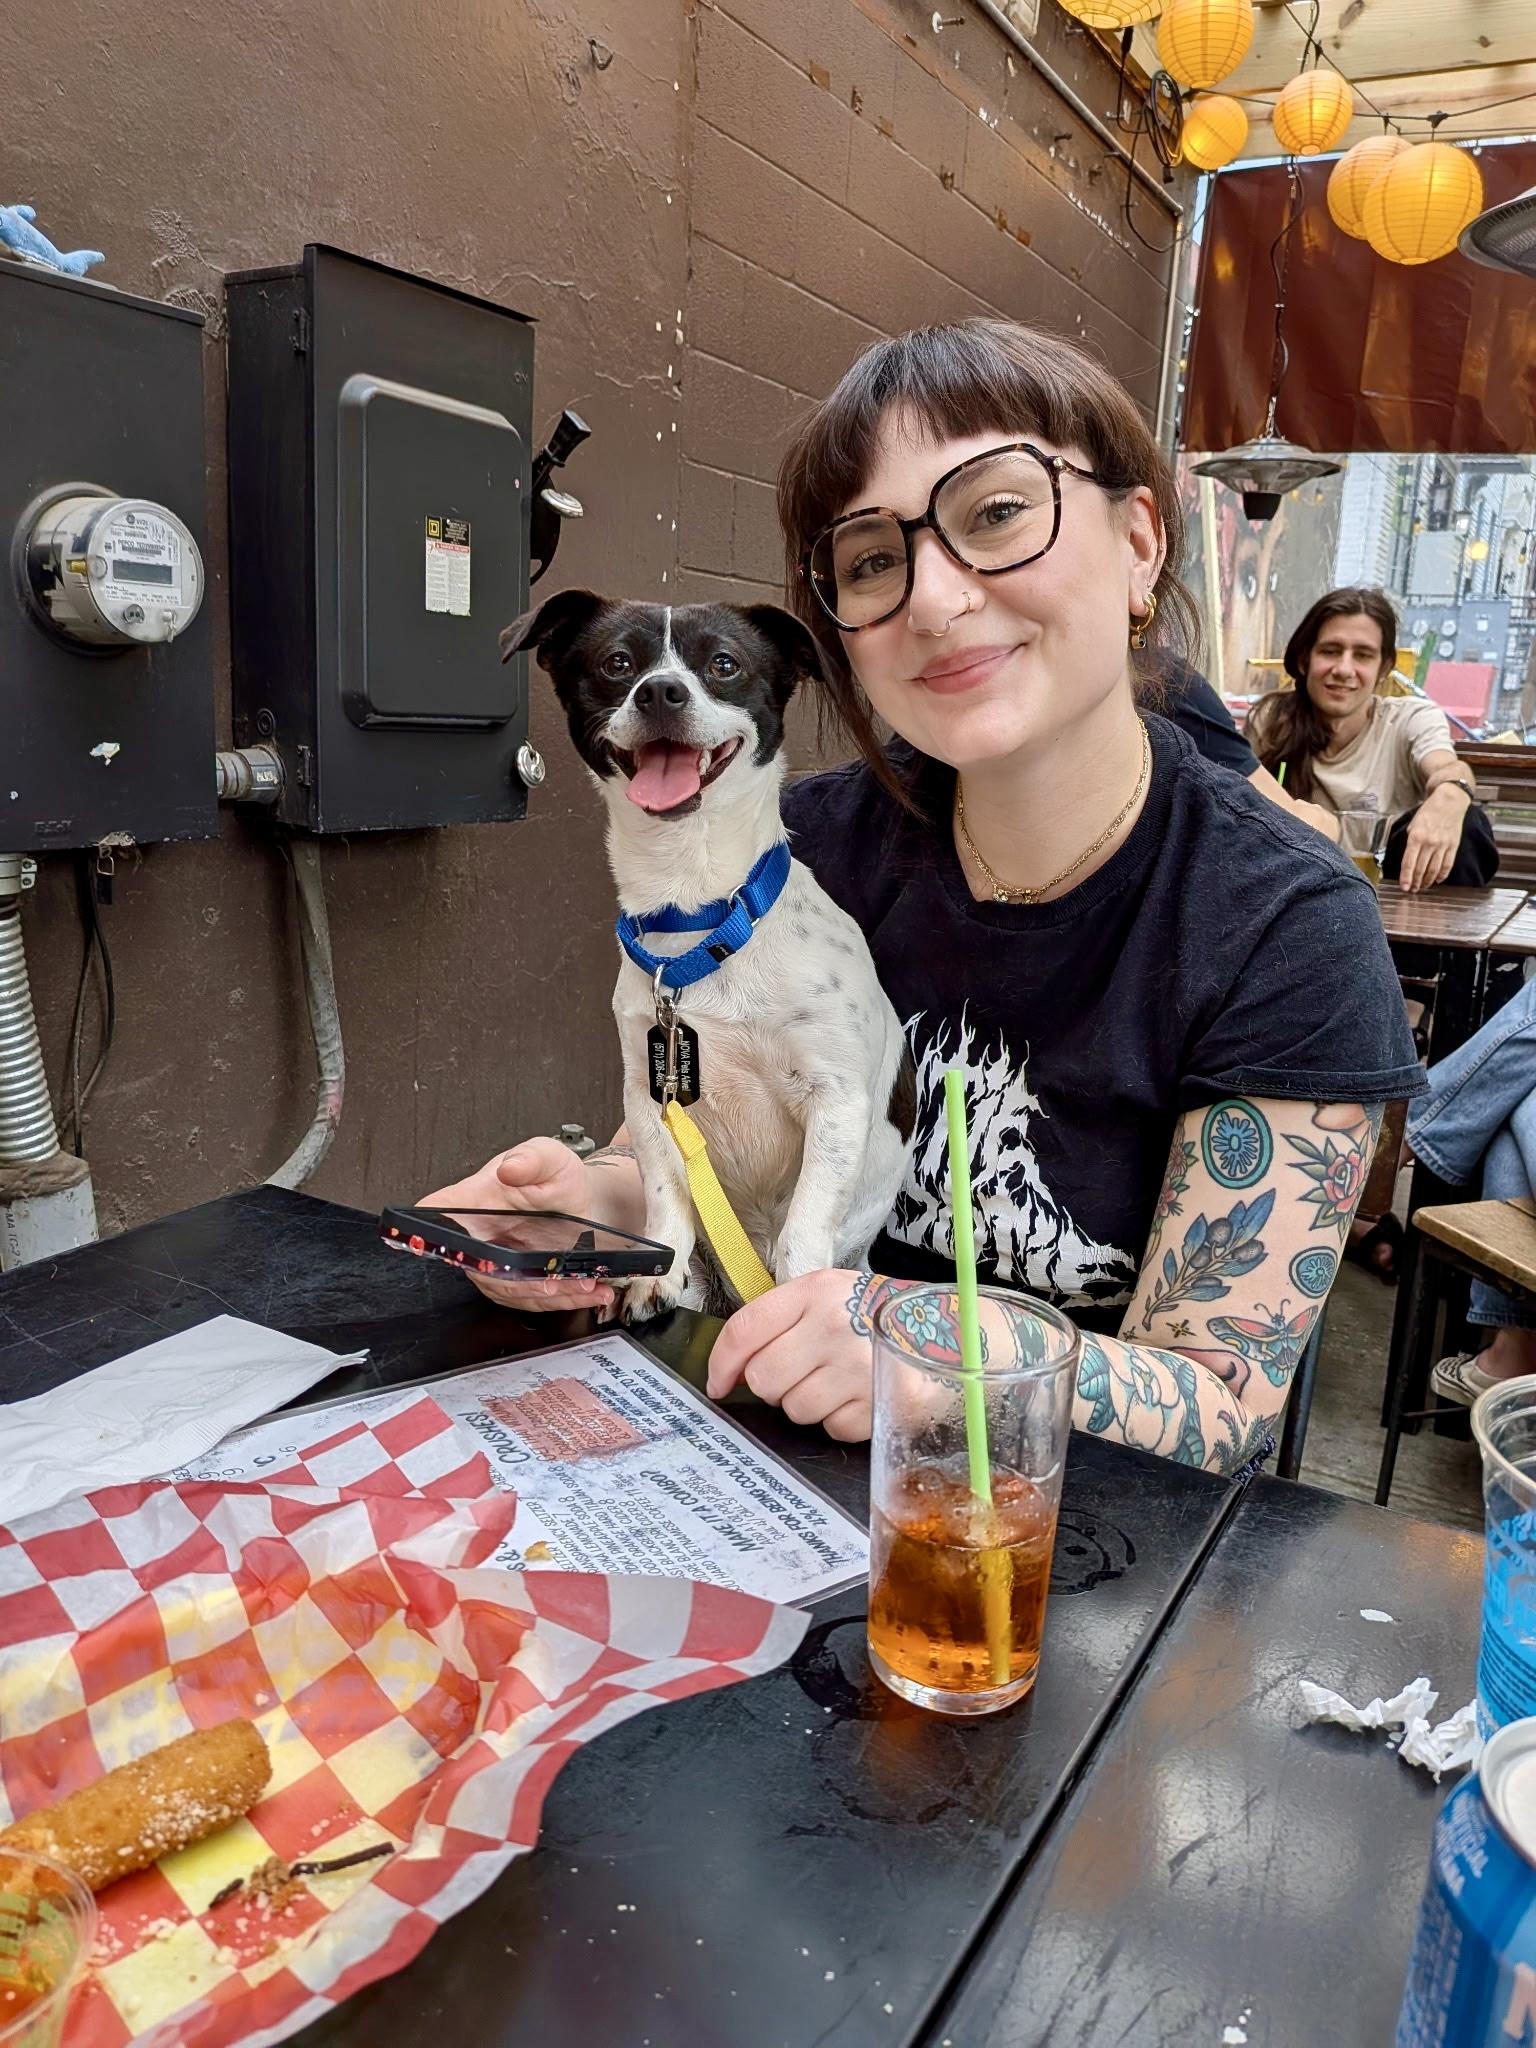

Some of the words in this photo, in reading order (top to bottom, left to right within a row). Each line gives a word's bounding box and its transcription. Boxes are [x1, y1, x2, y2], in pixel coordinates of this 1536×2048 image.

[652, 1042, 665, 1059] (571)
[681, 1040, 691, 1059] NOVA
[604, 1366, 628, 1379] THE
[620, 1378, 638, 1388] TO
[633, 1369, 674, 1396] PAYMENTS
[630, 1387, 670, 1414] EMPTIES
[665, 1396, 692, 1411] CASH
[598, 1417, 622, 1434] SODA
[684, 1412, 708, 1425] NON
[458, 1411, 530, 1463] CRUSHES!
[512, 1429, 540, 1445] THAT
[662, 1414, 714, 1452] RETURNING
[700, 1425, 719, 1435] TO
[529, 1446, 557, 1462] GET
[712, 1434, 745, 1457] ADDED
[706, 1452, 734, 1466] AND
[735, 1453, 759, 1466] FEE
[555, 1472, 579, 1488] SODA
[725, 1466, 757, 1488] COOL
[624, 1488, 643, 1497] 11
[640, 1470, 698, 1505] COMBO?
[752, 1467, 811, 1509] PROCESSING
[572, 1489, 603, 1511] ITALIAN
[702, 1492, 721, 1503] OF
[749, 1489, 787, 1513] BEING
[526, 1502, 557, 1527] SELTZER
[566, 1503, 591, 1520] SODA
[607, 1505, 632, 1524] CIDER
[627, 1507, 654, 1526] CIDER
[634, 1497, 665, 1519] COFFEE
[713, 1502, 734, 1515] POP
[733, 1504, 755, 1518] CALL
[800, 1507, 828, 1526] 4%
[594, 1511, 619, 1529] HARD
[698, 1515, 724, 1523] IT
[778, 1513, 808, 1531] FOR
[561, 1518, 602, 1552] LEMONADE
[582, 1521, 623, 1554] PINEAPPLE
[658, 1520, 708, 1560] VIETNAMESE
[712, 1519, 764, 1552] MAKE
[751, 1532, 776, 1548] ADD
[764, 1526, 789, 1541] RAIL
[549, 1528, 600, 1574] RANSPARENCY
[611, 1530, 645, 1557] ORANGE
[625, 1526, 674, 1565] BLACKBERRY
[660, 1539, 691, 1562] BLANC
[798, 1531, 849, 1568] THANKS
[617, 1555, 642, 1576] ODKA
[665, 1567, 687, 1580] AST
[701, 1560, 729, 1579] HARD
